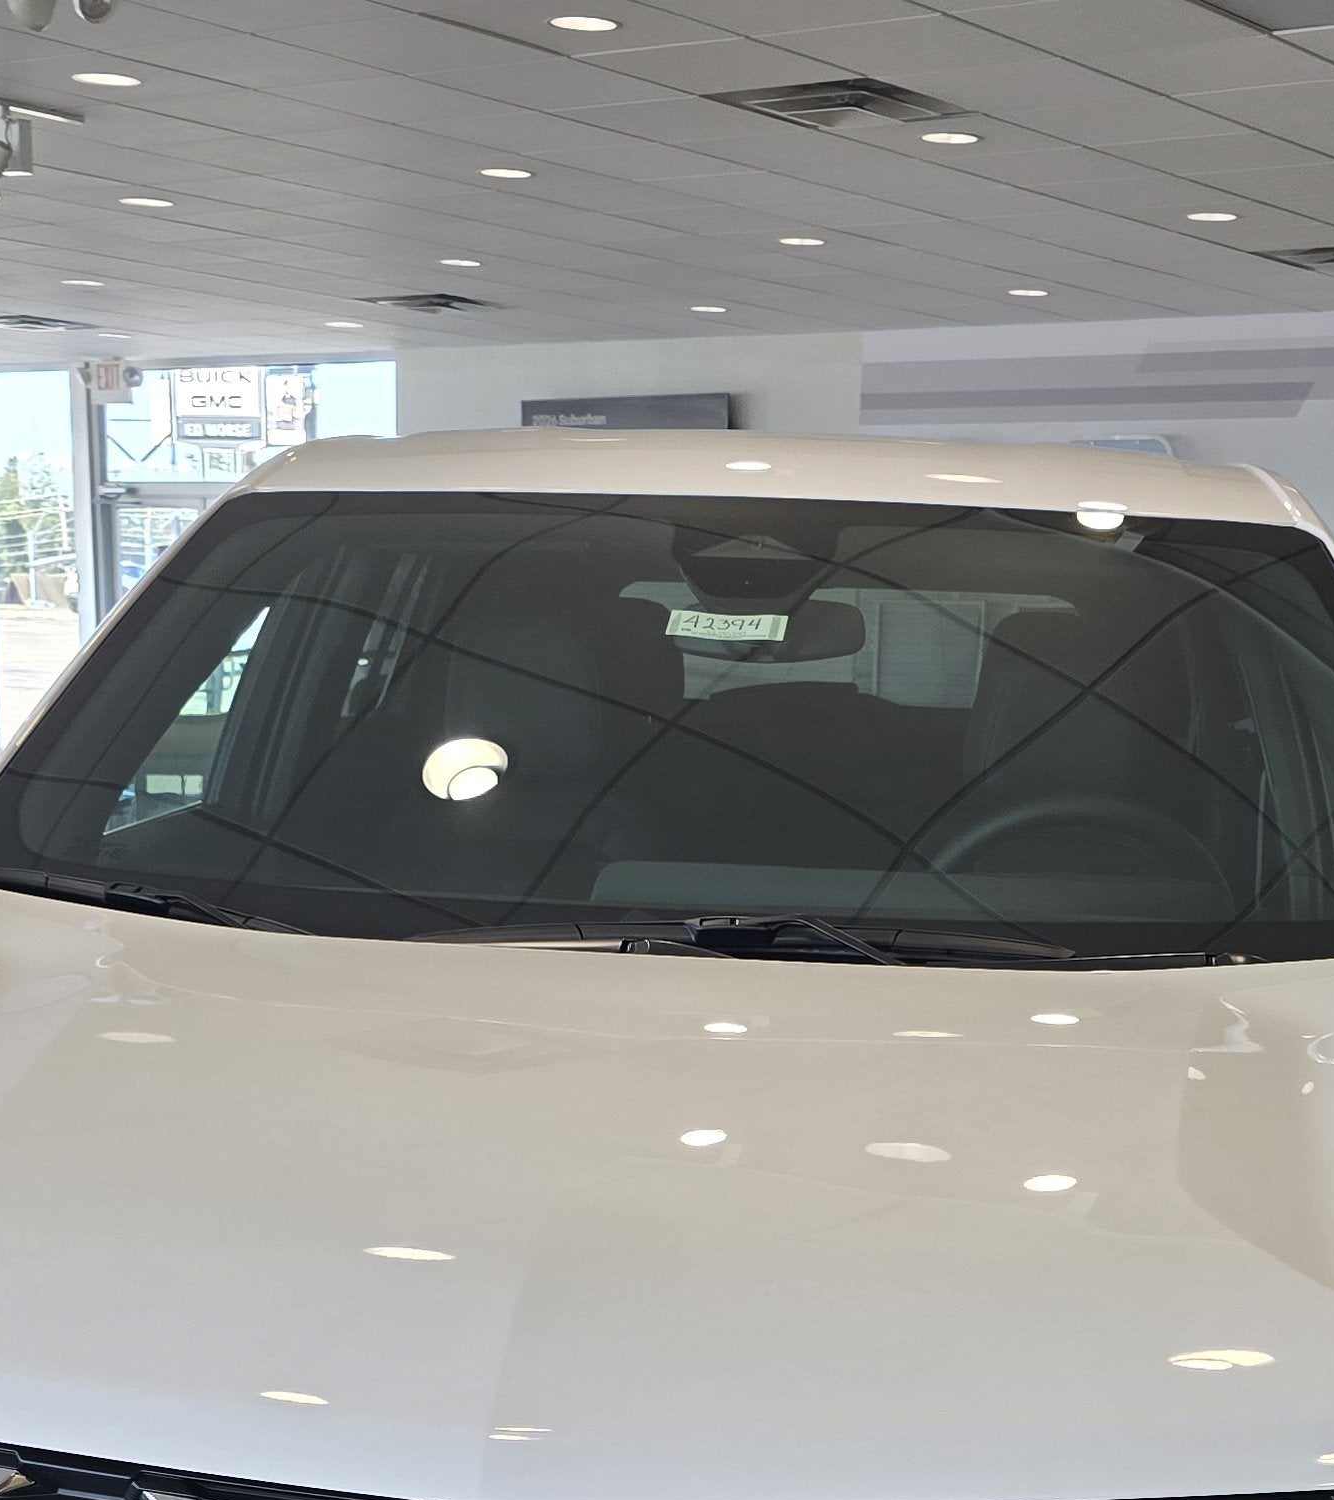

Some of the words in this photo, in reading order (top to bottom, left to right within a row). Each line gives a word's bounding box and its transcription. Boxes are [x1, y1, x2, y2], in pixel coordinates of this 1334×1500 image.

[97, 363, 120, 390] EXIT
[179, 369, 251, 383] BUICK
[191, 395, 241, 408] GMC
